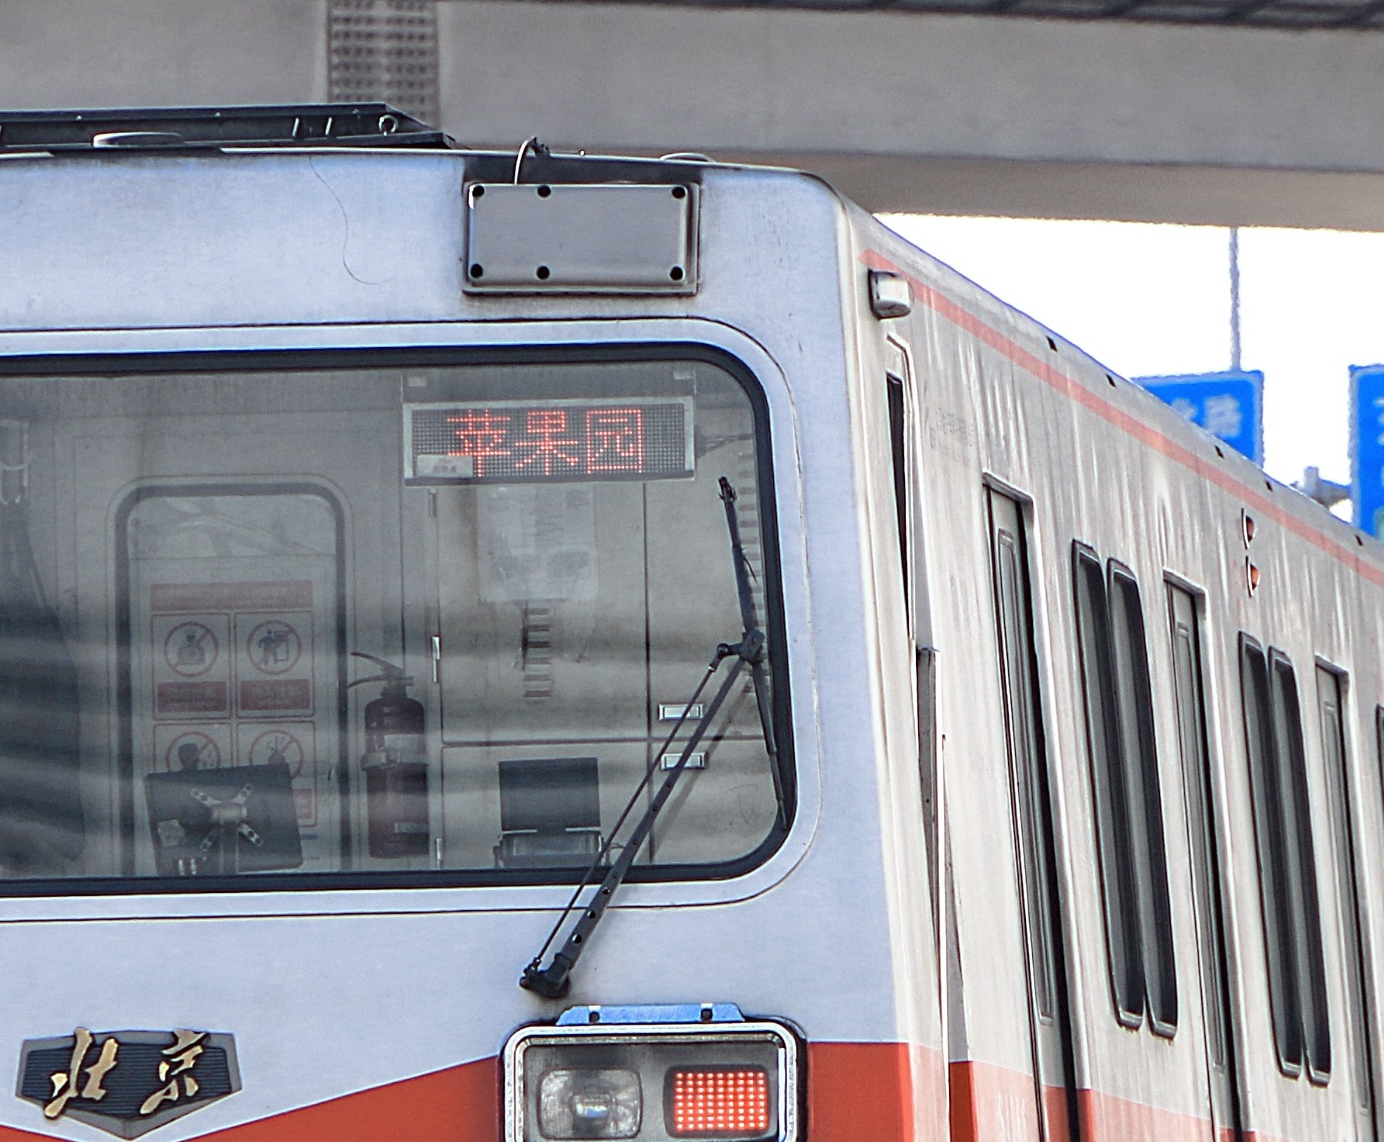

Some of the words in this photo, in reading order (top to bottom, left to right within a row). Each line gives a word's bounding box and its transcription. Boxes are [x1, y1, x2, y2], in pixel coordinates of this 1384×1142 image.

[446, 408, 644, 477] 苹果园
[44, 1027, 209, 1120] 北京
